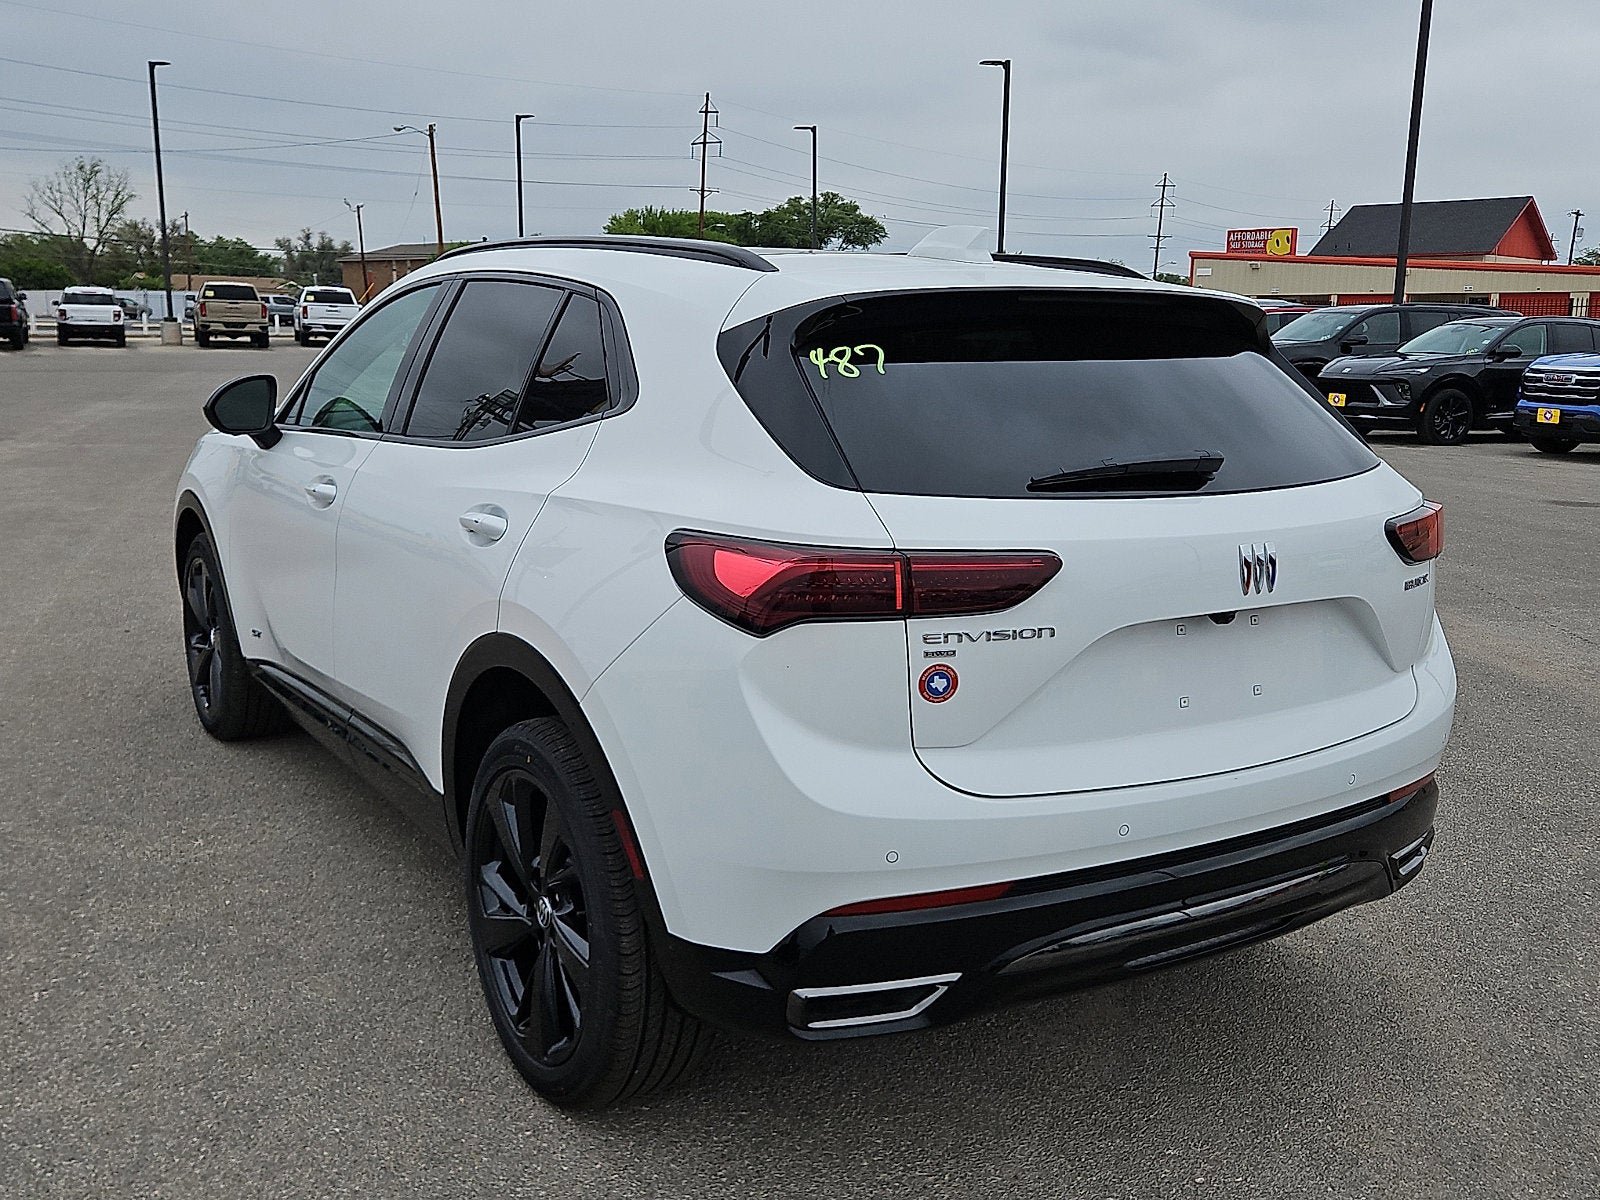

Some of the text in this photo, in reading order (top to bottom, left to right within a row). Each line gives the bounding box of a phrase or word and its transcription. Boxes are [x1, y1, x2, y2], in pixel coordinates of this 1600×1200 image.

[1229, 230, 1273, 241] AFFORDABLE
[1230, 240, 1265, 249] SELF STORAGE
[809, 343, 886, 379] 487
[922, 627, 1056, 645] ENVISION
[924, 649, 957, 658] AWD
